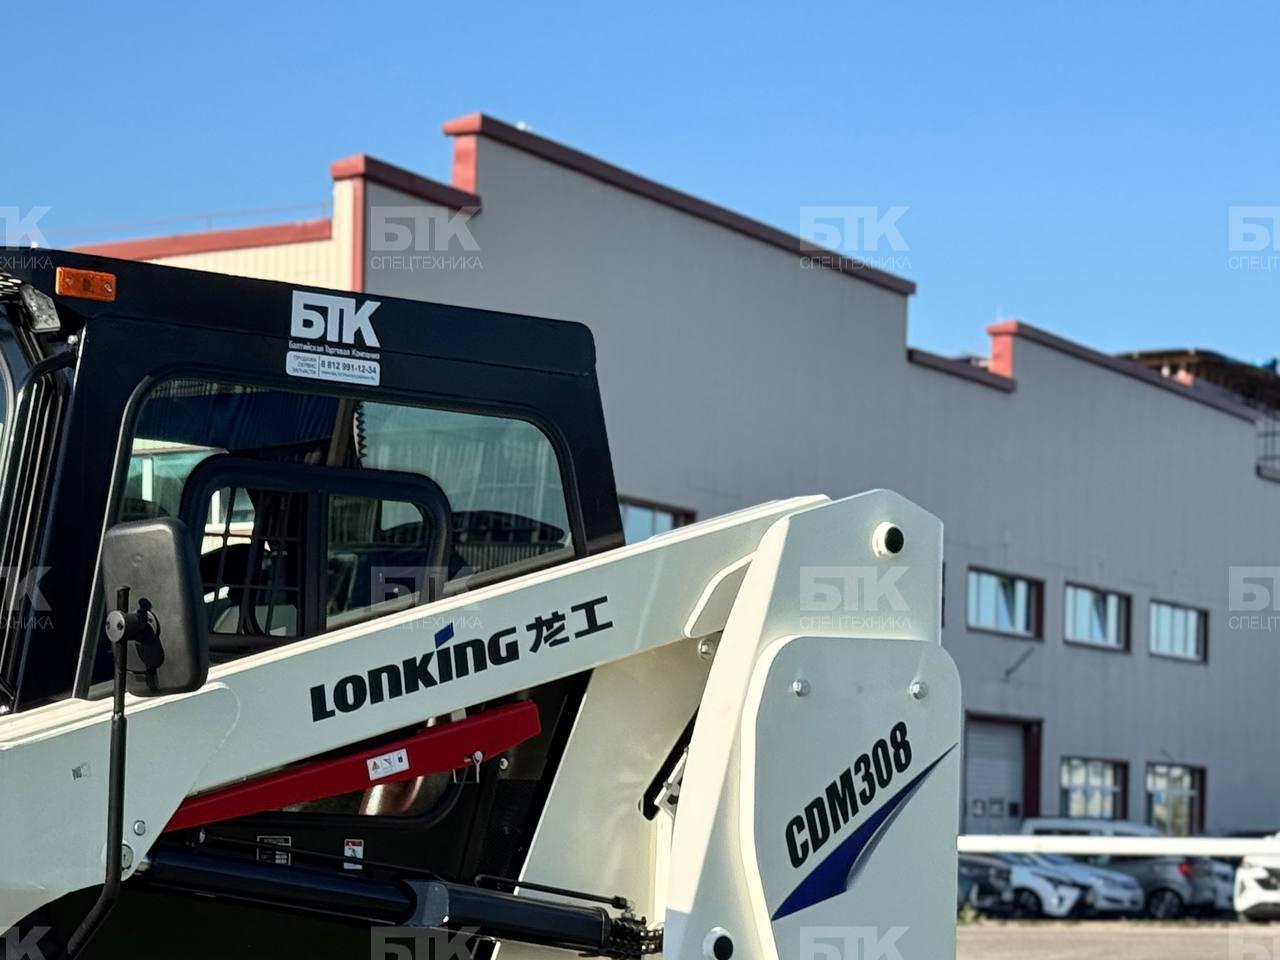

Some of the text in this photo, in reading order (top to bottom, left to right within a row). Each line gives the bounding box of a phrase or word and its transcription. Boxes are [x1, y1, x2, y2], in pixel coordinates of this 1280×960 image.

[291, 290, 381, 347] БТК
[327, 361, 340, 370] 812
[526, 596, 613, 654] 龙工
[785, 721, 912, 868] CDM308
